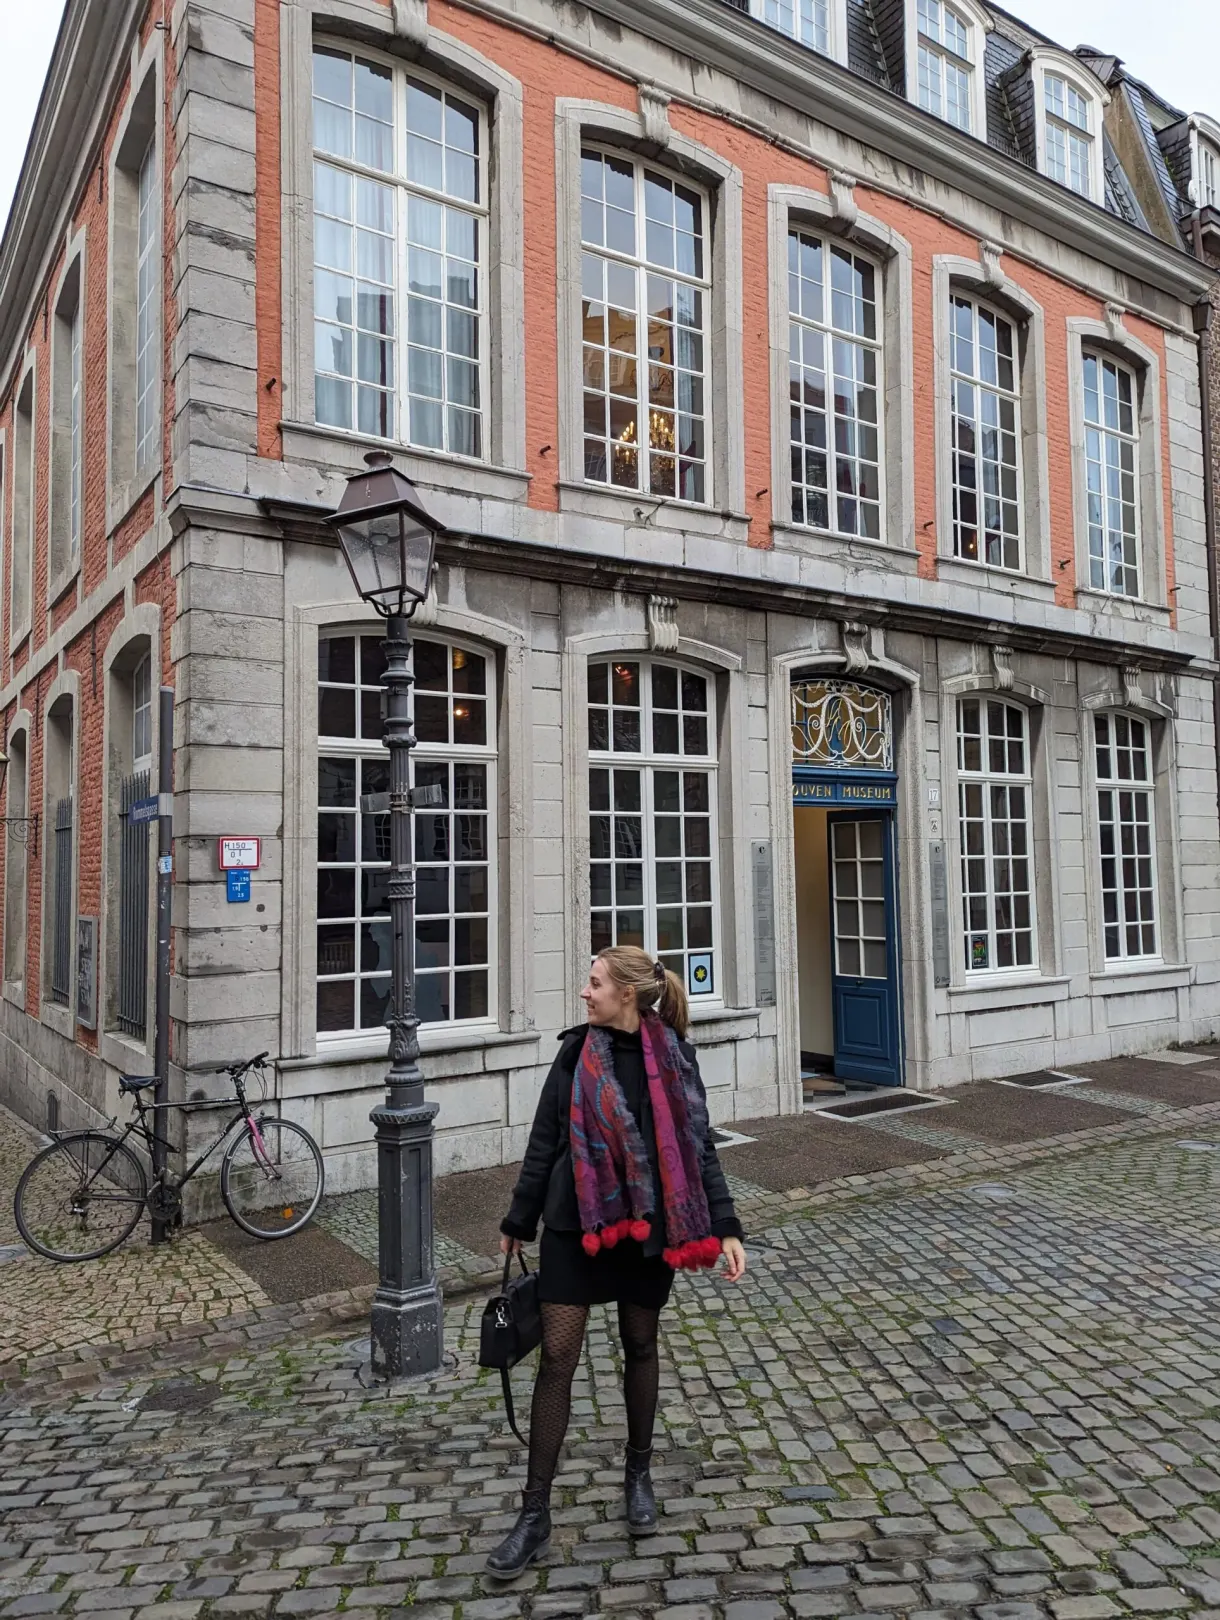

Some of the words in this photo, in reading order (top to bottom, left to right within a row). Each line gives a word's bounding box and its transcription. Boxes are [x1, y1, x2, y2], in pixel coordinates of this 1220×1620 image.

[791, 784, 831, 797] OUVEN
[843, 786, 891, 799] MUSEUM
[929, 789, 938, 801] 17
